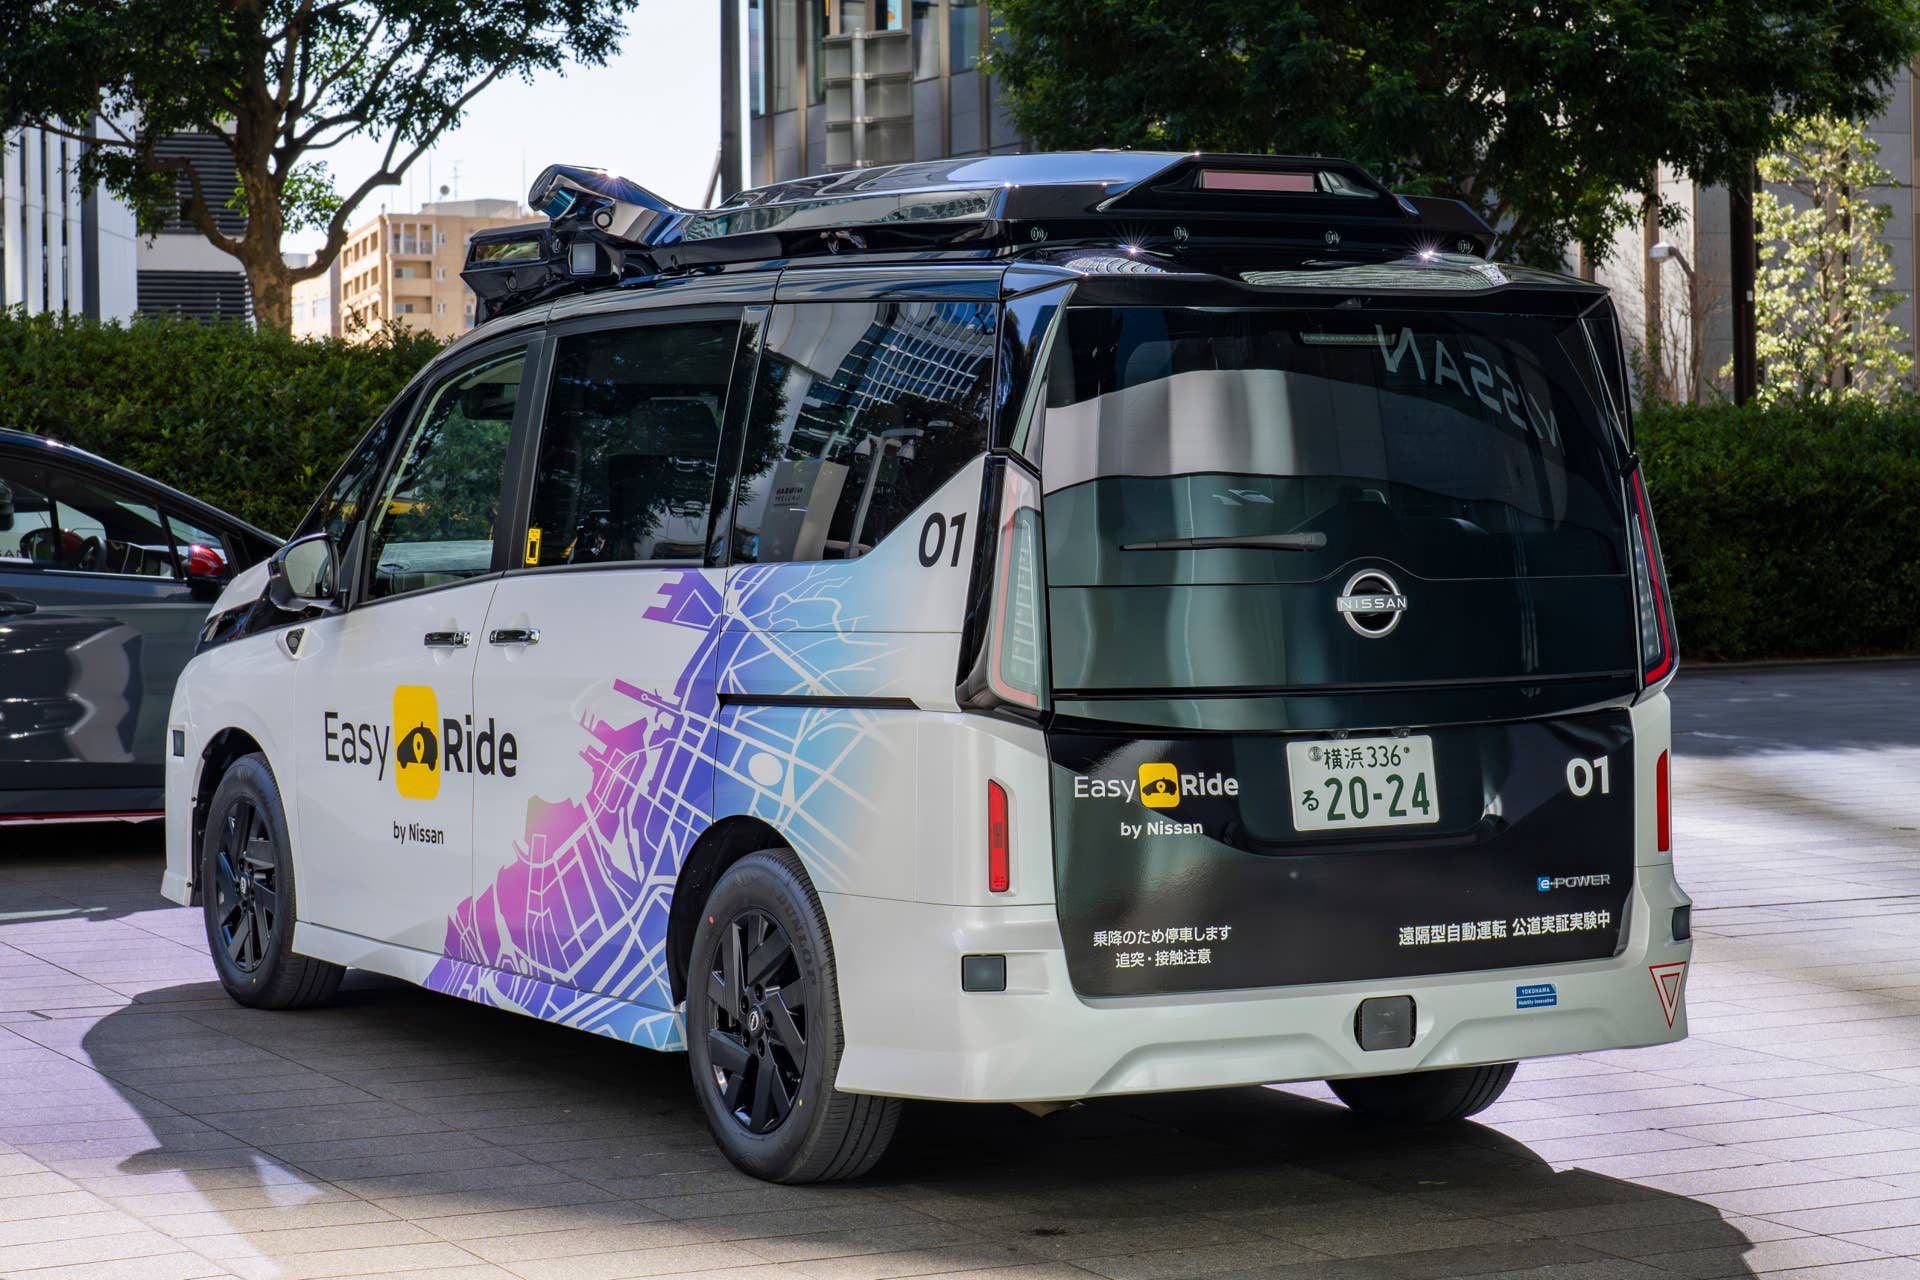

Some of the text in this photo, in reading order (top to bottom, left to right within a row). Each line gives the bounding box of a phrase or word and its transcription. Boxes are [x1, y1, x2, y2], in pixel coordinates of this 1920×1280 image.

[918, 511, 967, 568] 01
[1340, 596, 1407, 610] NISSAN
[324, 711, 518, 781] Easy Ride
[1074, 772, 1239, 803] Easy Ride
[1566, 755, 1610, 797] 01
[1302, 772, 1431, 821] る 20-24
[393, 821, 444, 844] by Nissan
[1120, 820, 1204, 839] by Nissan
[1540, 873, 1611, 890] e-POWER
[1093, 925, 1232, 947] 乗降のため停車します
[1399, 909, 1611, 946] 遠隔型自動運転 公道実証実験中
